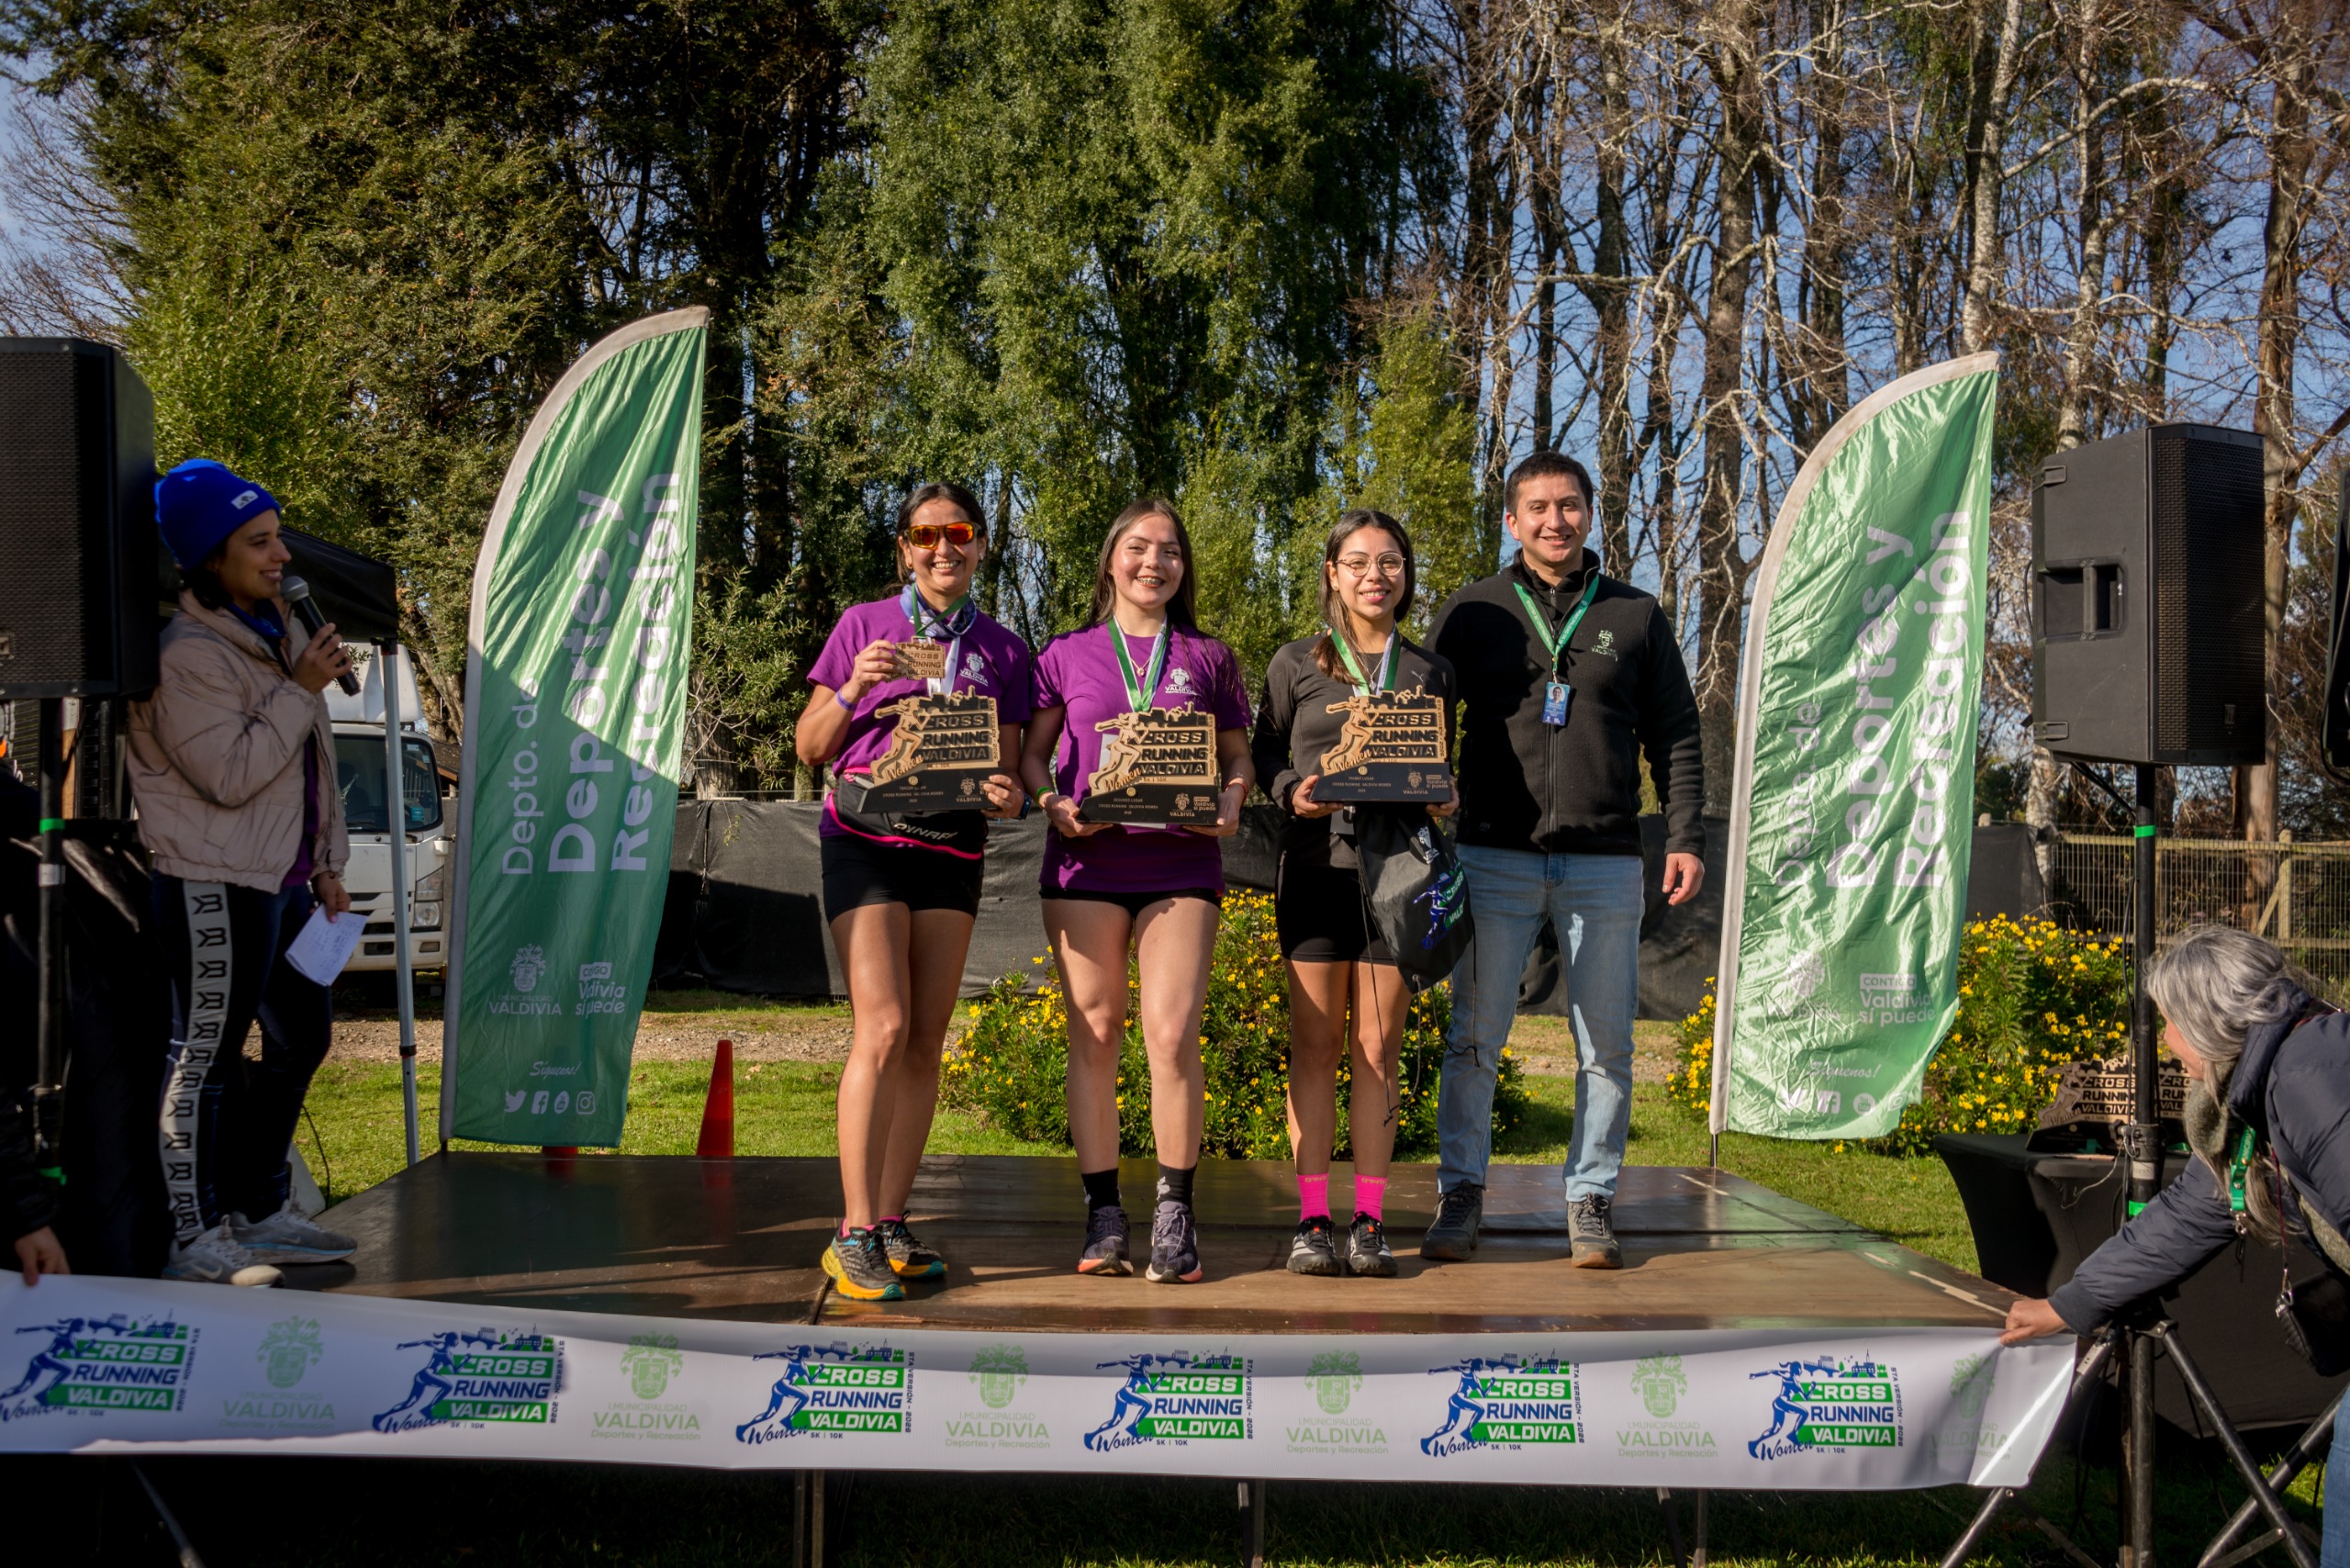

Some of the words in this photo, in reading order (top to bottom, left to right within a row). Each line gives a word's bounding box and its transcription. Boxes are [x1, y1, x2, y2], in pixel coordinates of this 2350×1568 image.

[578, 490, 624, 530] y
[611, 473, 680, 871] Recreación
[516, 678, 538, 728] de
[1827, 584, 1900, 888] Deportes
[1867, 526, 1914, 566] y
[1893, 510, 1970, 887] Recreación
[548, 548, 612, 872] Deportes
[925, 715, 984, 729] CROSS
[1375, 714, 1432, 725] CROSS
[1788, 701, 1822, 751] de
[923, 731, 989, 746] RUNNING
[1145, 733, 1203, 744] CROSS
[1372, 730, 1438, 743] RUNNING
[922, 748, 988, 760] VALDIVIA
[1141, 747, 1207, 761] RUNNING
[1371, 746, 1434, 756] VALDIVIA
[885, 754, 923, 781] Women
[1333, 749, 1371, 771] Women
[1140, 763, 1204, 775] VALDIVIA
[1103, 767, 1142, 791] Women
[502, 741, 544, 874] Depto.
[1860, 991, 1932, 1008] Valdivia
[489, 1002, 562, 1015] VALDIVIA
[1880, 1006, 1936, 1028] puede
[2083, 1091, 2135, 1102] RUNNIN
[82, 1341, 179, 1362] CROSS
[72, 1363, 181, 1385] RUNNING
[460, 1358, 547, 1375] CROSS
[815, 1369, 898, 1384] CROSS
[1155, 1376, 1237, 1393] CROSS
[67, 1387, 169, 1407] VALDIVIA
[453, 1379, 551, 1399] RUNNING
[1490, 1381, 1566, 1397] CROSS
[1811, 1384, 1886, 1400] CROSS
[810, 1390, 903, 1408] RUNNING
[1155, 1398, 1242, 1416] RUNNING
[223, 1400, 336, 1420] VALDIVIA
[449, 1402, 543, 1420] VALDIVIA
[1486, 1403, 1572, 1419] RUNNING
[1811, 1406, 1894, 1423] RUNNING
[384, 1415, 449, 1434] Women
[592, 1412, 700, 1430] VALDIVIA
[809, 1412, 898, 1429] VALDIVIA
[1153, 1420, 1240, 1436] VALDIVIA
[590, 1430, 635, 1439] Deportes
[646, 1429, 701, 1440] Recreación
[746, 1424, 809, 1445] Women
[946, 1421, 1049, 1439] VALDIVIA
[1286, 1427, 1387, 1444] VALDIVIA
[1486, 1425, 1572, 1440] VALDIVIA
[1812, 1428, 1892, 1443] VALDIVIA
[946, 1439, 990, 1449] Deportes
[991, 1440, 997, 1449] y
[999, 1439, 1050, 1449] Recreación
[1095, 1432, 1154, 1452] Women
[1433, 1436, 1489, 1457] Women
[1617, 1431, 1716, 1447] VALDIVIA
[1287, 1445, 1329, 1454] Deportes
[1338, 1444, 1388, 1454] Recreación
[1618, 1449, 1660, 1458] Deportes
[1661, 1450, 1666, 1459] y
[1669, 1448, 1718, 1458] Recreación
[1761, 1439, 1813, 1461] Women
